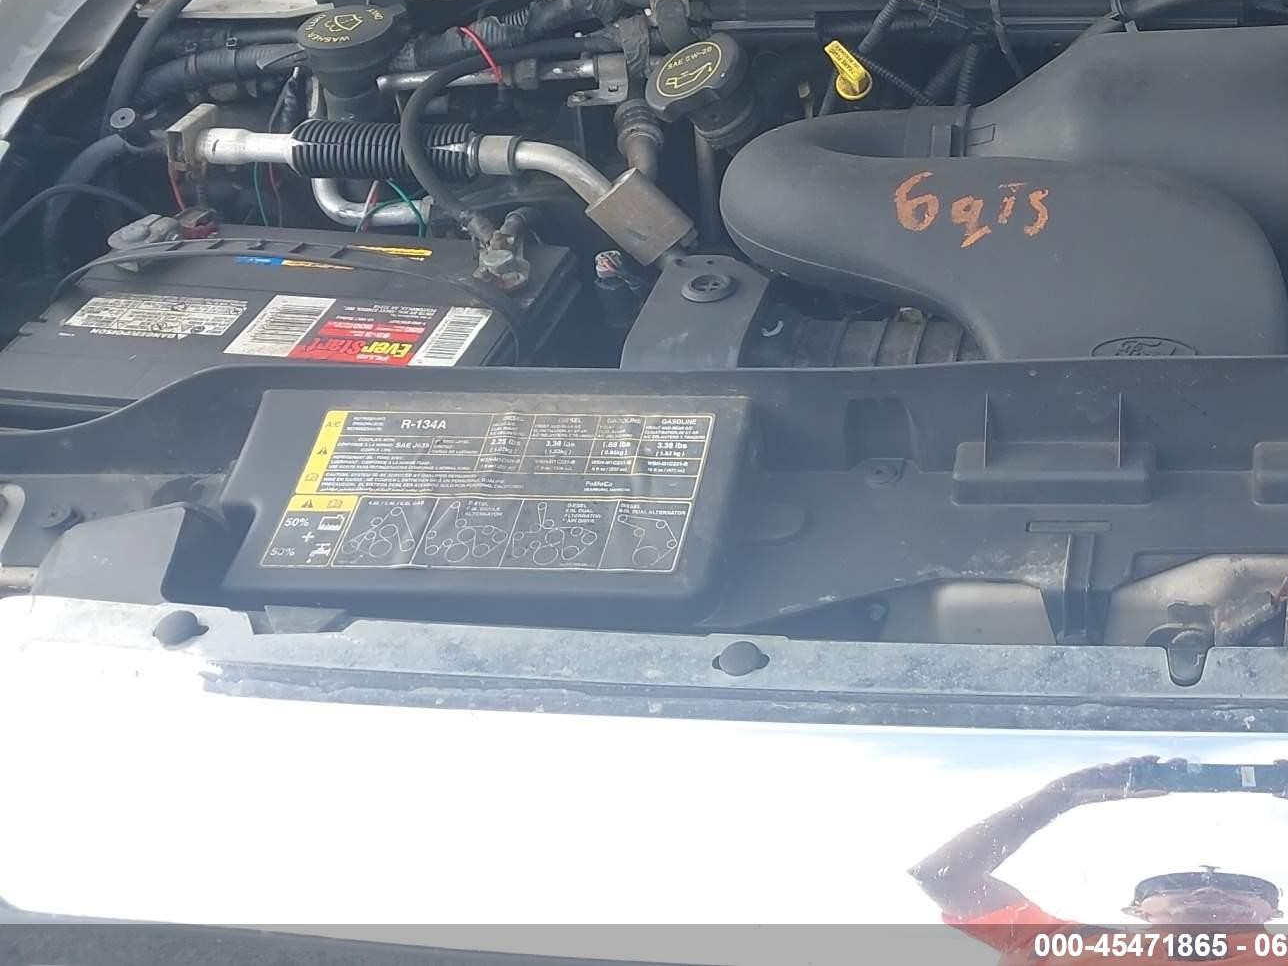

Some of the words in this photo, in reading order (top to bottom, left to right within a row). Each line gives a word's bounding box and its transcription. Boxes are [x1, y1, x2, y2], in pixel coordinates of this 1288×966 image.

[307, 32, 351, 43] WASHER
[666, 59, 684, 70] SAE
[307, 337, 413, 359] EverStart
[400, 419, 447, 430] R-134A
[283, 518, 310, 527] 50%
[270, 547, 296, 557] 50%
